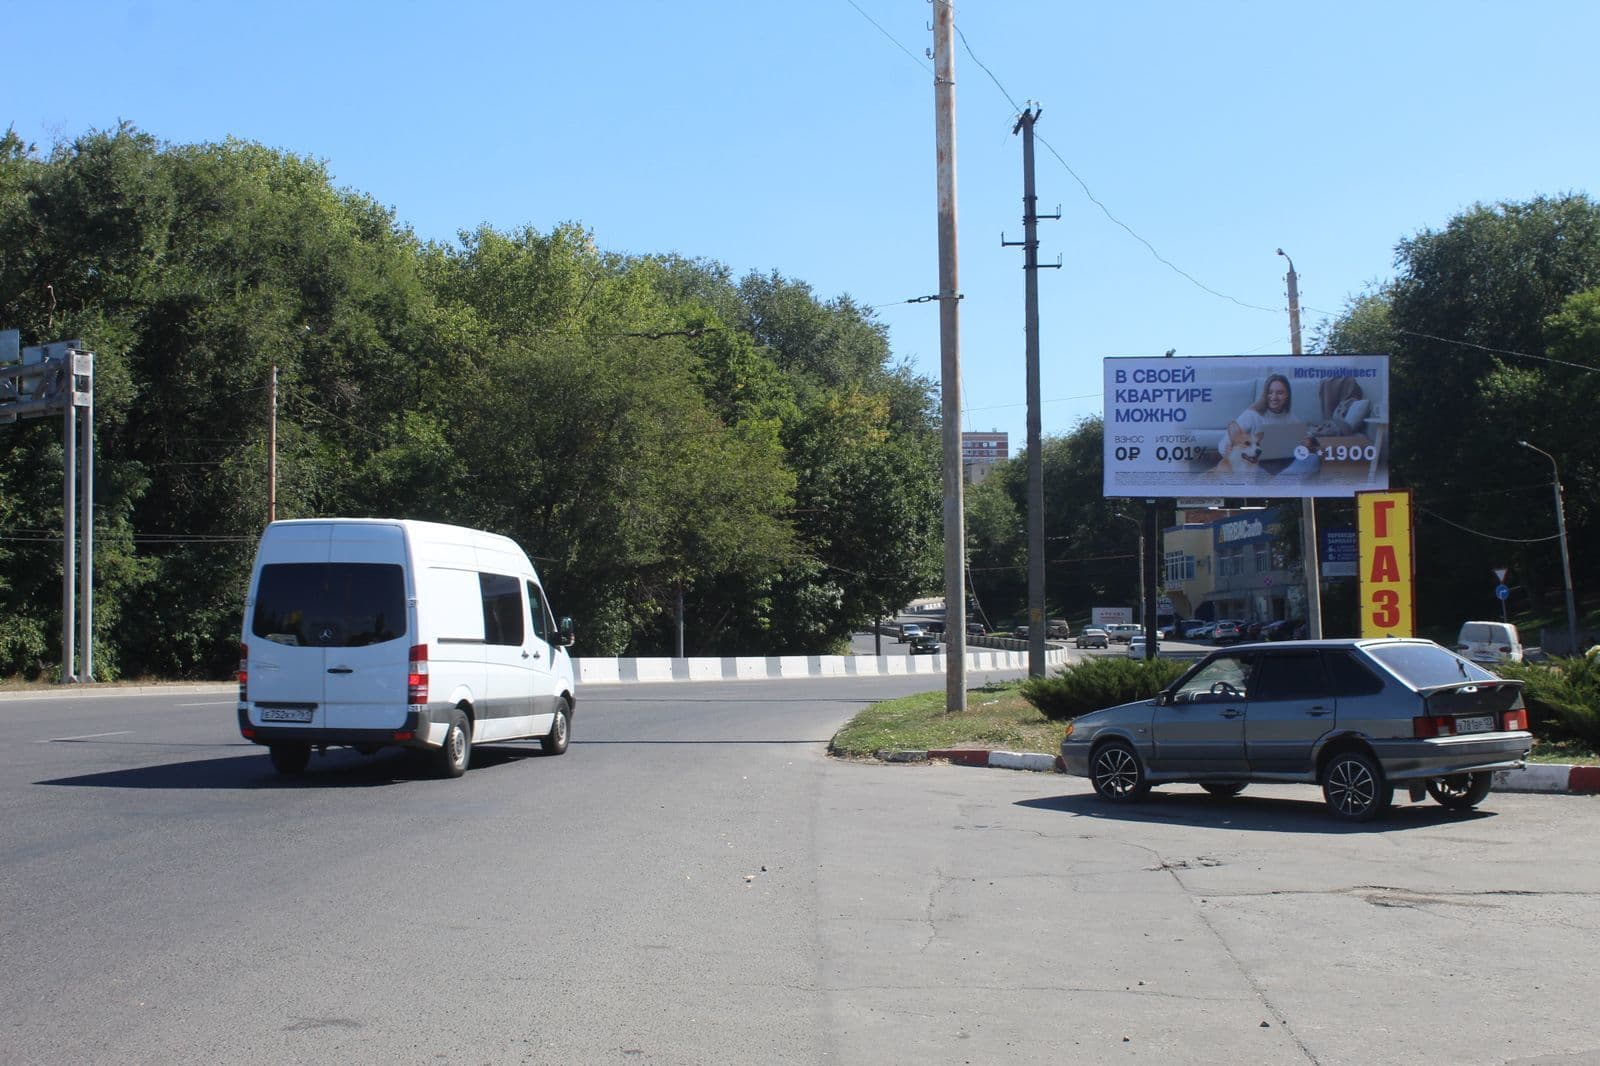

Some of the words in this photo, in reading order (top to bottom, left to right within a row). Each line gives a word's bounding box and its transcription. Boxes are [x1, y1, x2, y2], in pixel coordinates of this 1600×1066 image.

[1115, 370, 1127, 383] В
[1133, 366, 1195, 383] СВОЕЙ
[1294, 367, 1377, 379] ЮгСтройИнвест
[1115, 388, 1212, 403] КВАРТИРЕ
[1115, 408, 1187, 422] МОЖНО
[1115, 435, 1144, 443] ВЗНОС
[1155, 435, 1197, 443] ИПОТЕКА
[1156, 446, 1206, 463] 0,01%
[1370, 500, 1401, 628] ГАЗ
